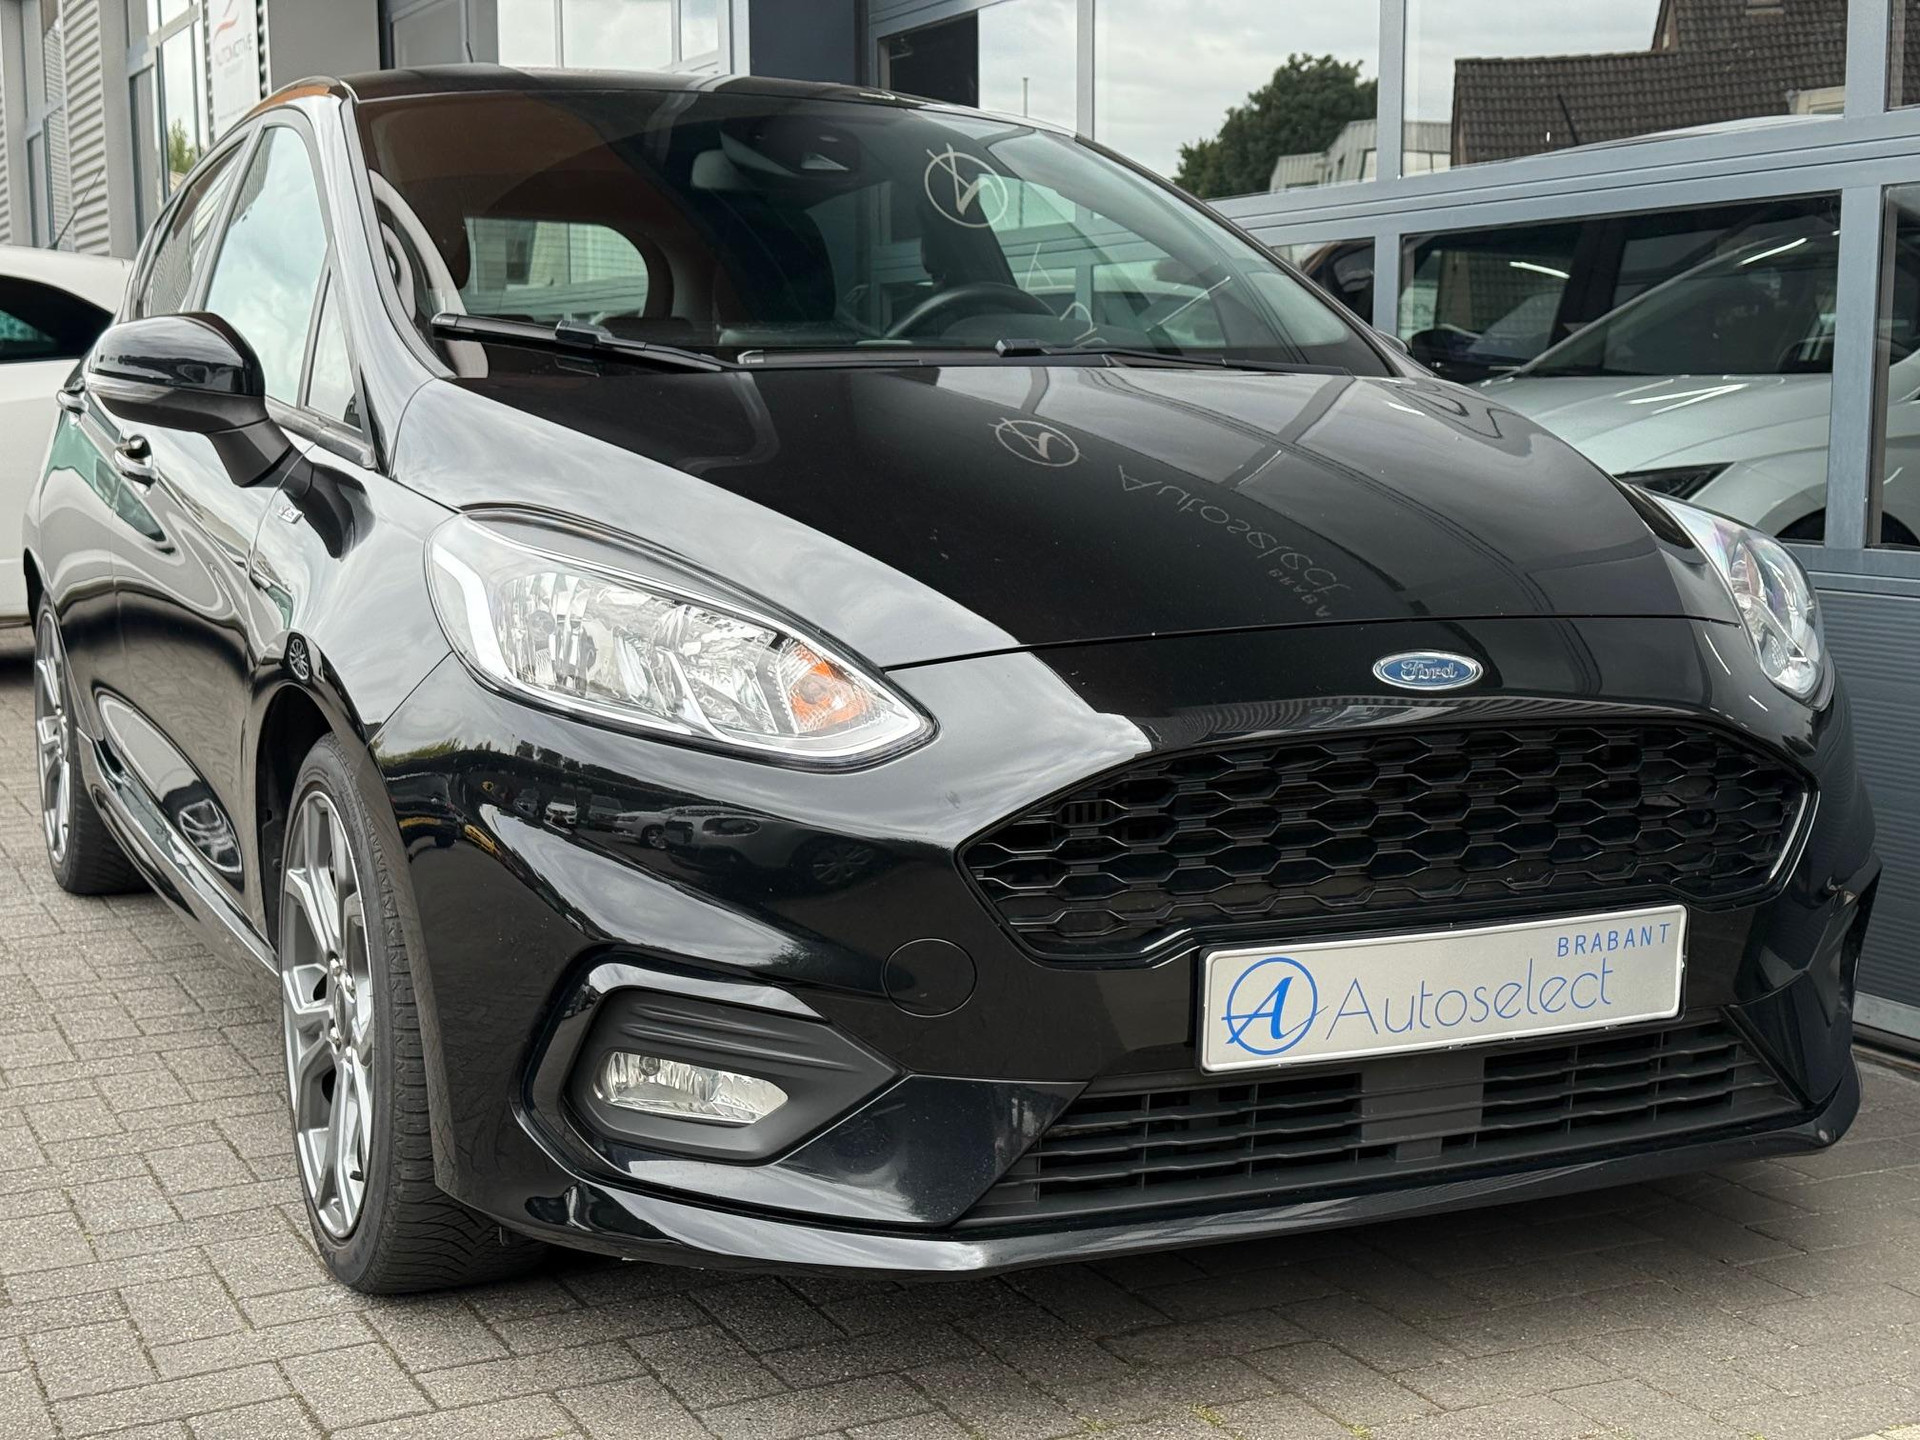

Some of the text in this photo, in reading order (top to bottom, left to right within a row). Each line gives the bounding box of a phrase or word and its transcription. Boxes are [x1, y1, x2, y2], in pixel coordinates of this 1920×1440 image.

[1400, 659, 1459, 681] Ford
[1557, 923, 1672, 958] BRABANT
[1325, 957, 1614, 1041] Autoselect
